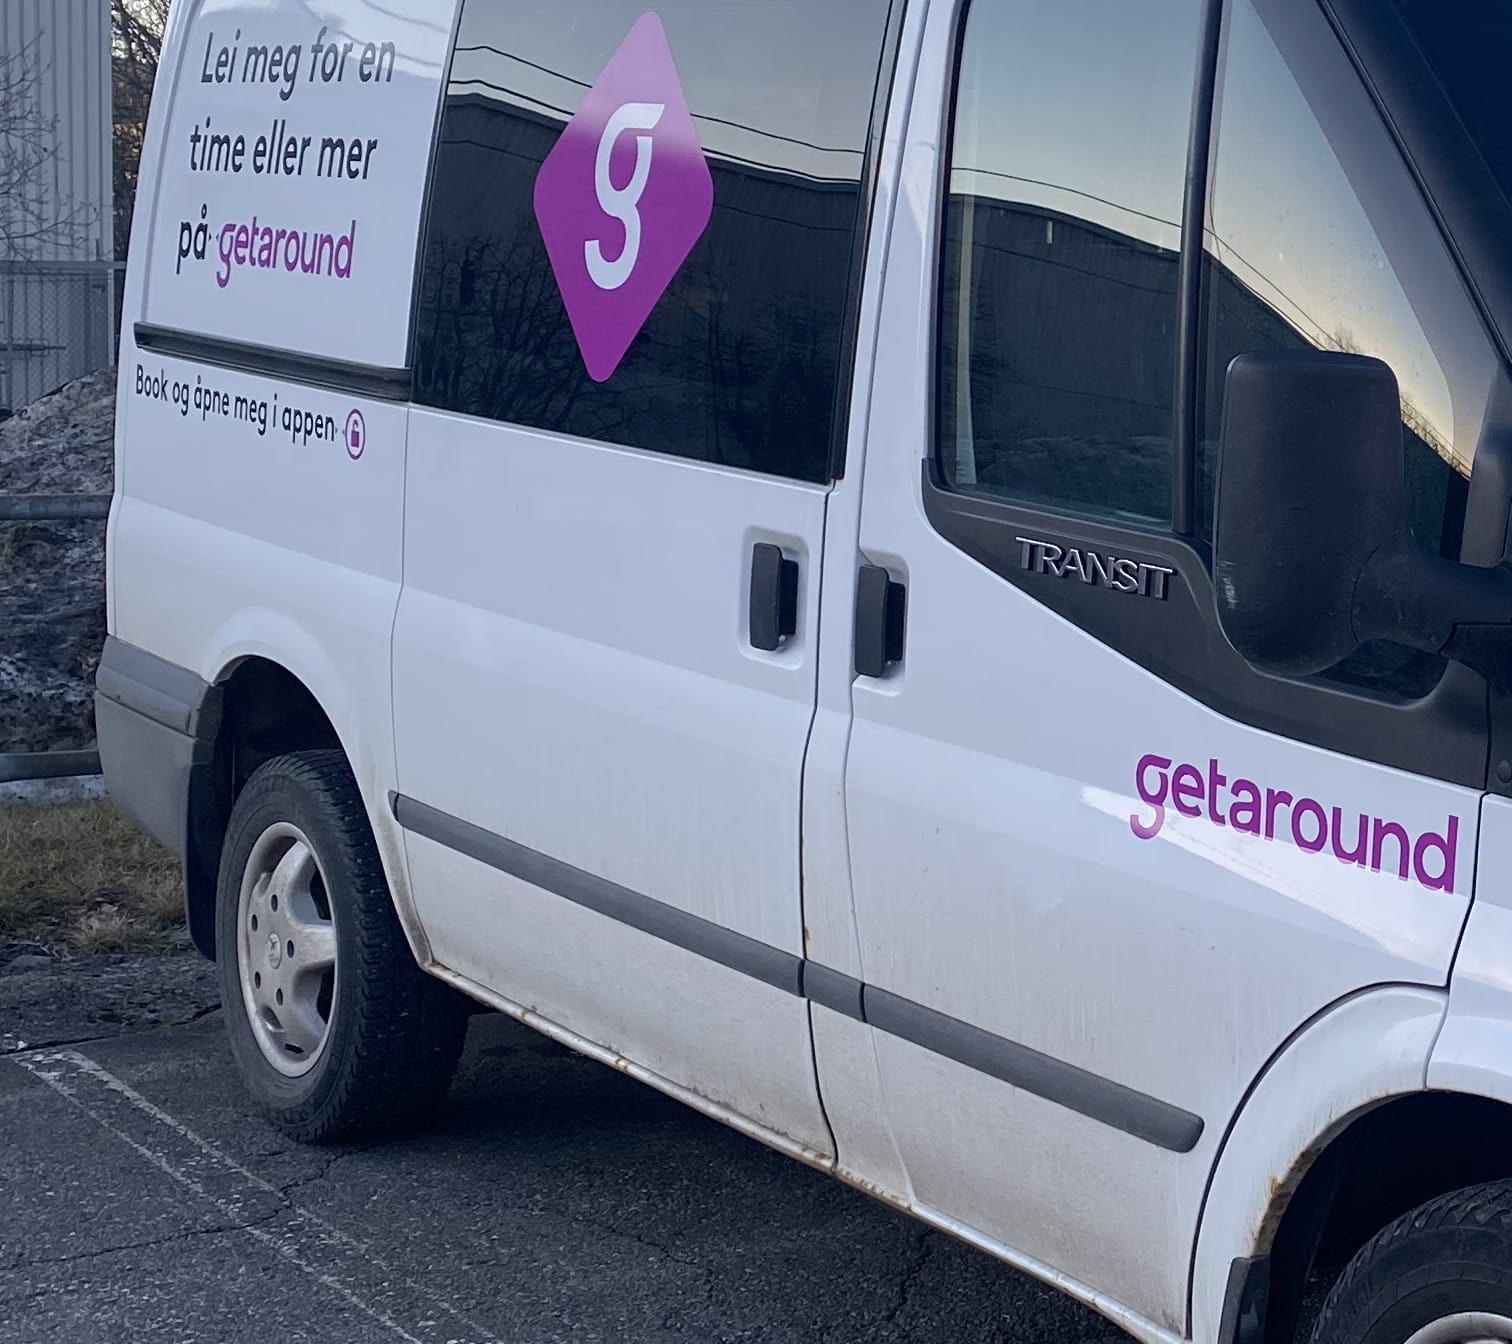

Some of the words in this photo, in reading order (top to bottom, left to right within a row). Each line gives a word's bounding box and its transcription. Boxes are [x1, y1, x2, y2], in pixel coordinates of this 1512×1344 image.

[200, 28, 241, 83] Lei
[242, 44, 302, 101] meg
[308, 26, 353, 82] for
[358, 41, 396, 82] en
[190, 116, 246, 173] time
[252, 119, 312, 176] eller
[317, 136, 378, 180] mer
[176, 203, 208, 275] på
[216, 216, 356, 288] getaround
[135, 363, 168, 401] Book
[172, 380, 190, 416] og
[193, 375, 230, 421] åpne
[233, 394, 267, 436] meg
[272, 392, 278, 428] i
[282, 406, 335, 446] appen
[1015, 536, 1175, 600] TRANSIT
[1129, 753, 1459, 895] getaround
